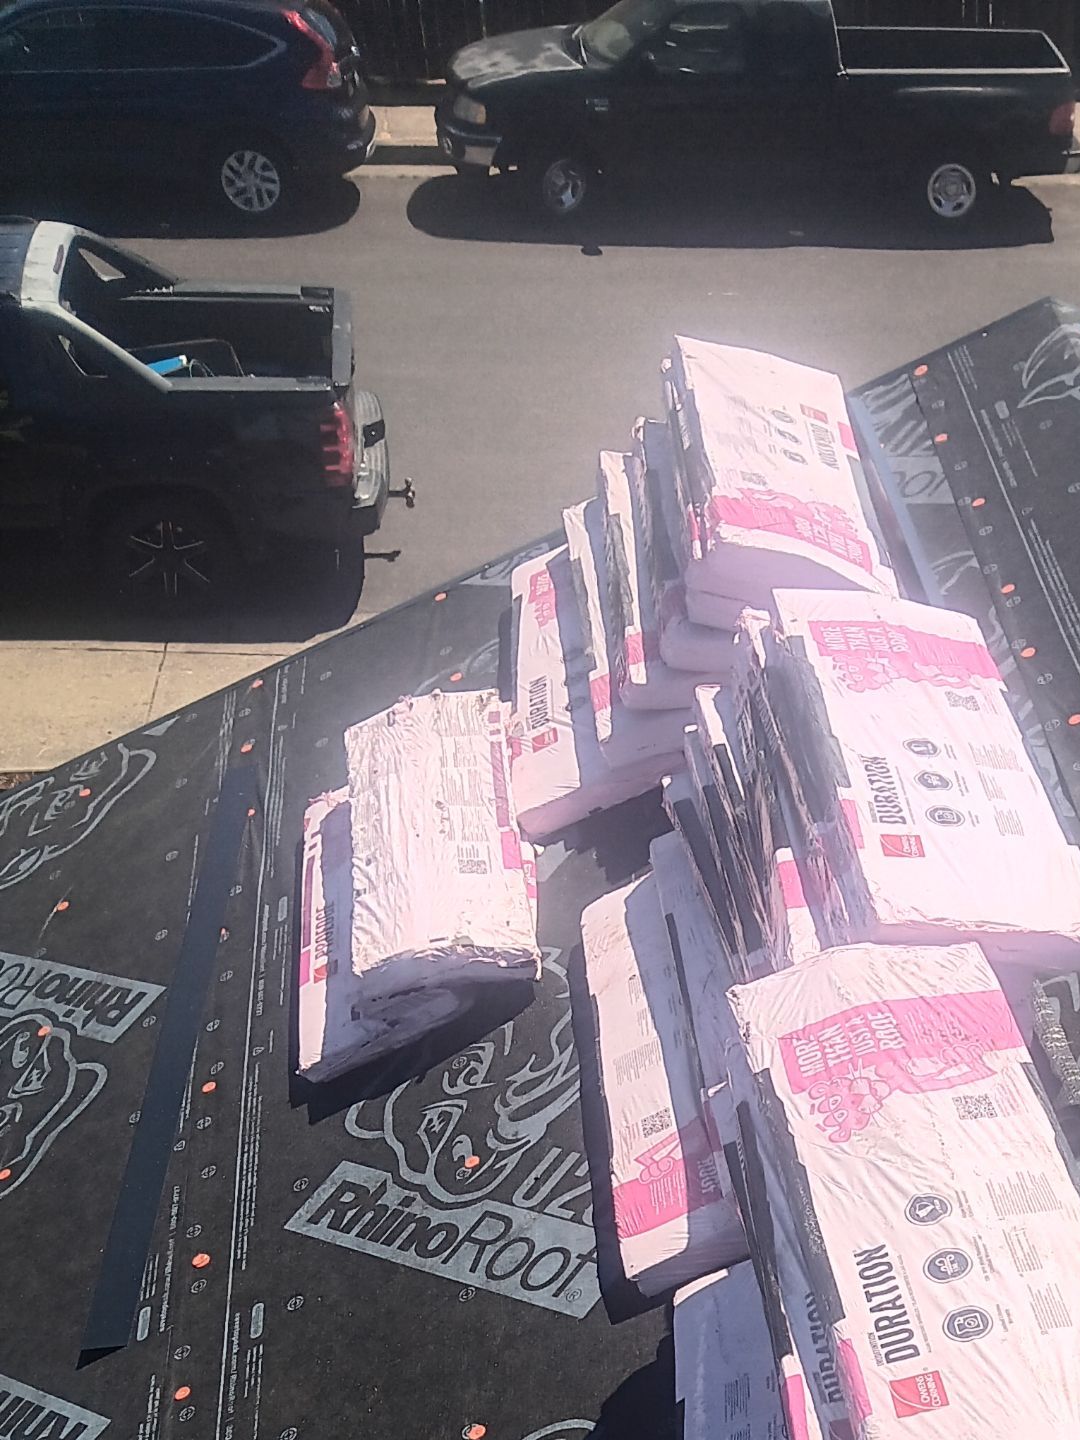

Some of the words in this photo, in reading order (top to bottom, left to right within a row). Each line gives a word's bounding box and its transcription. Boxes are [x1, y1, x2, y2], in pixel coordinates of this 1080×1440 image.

[528, 675, 549, 730] DURATION
[859, 753, 908, 825] DURATION
[817, 1023, 854, 1067] THAN
[309, 1179, 598, 1299] RhinoRoof
[853, 1244, 920, 1365] DURATION
[915, 1375, 931, 1404] OWENS
[924, 1373, 942, 1407] CORNING
